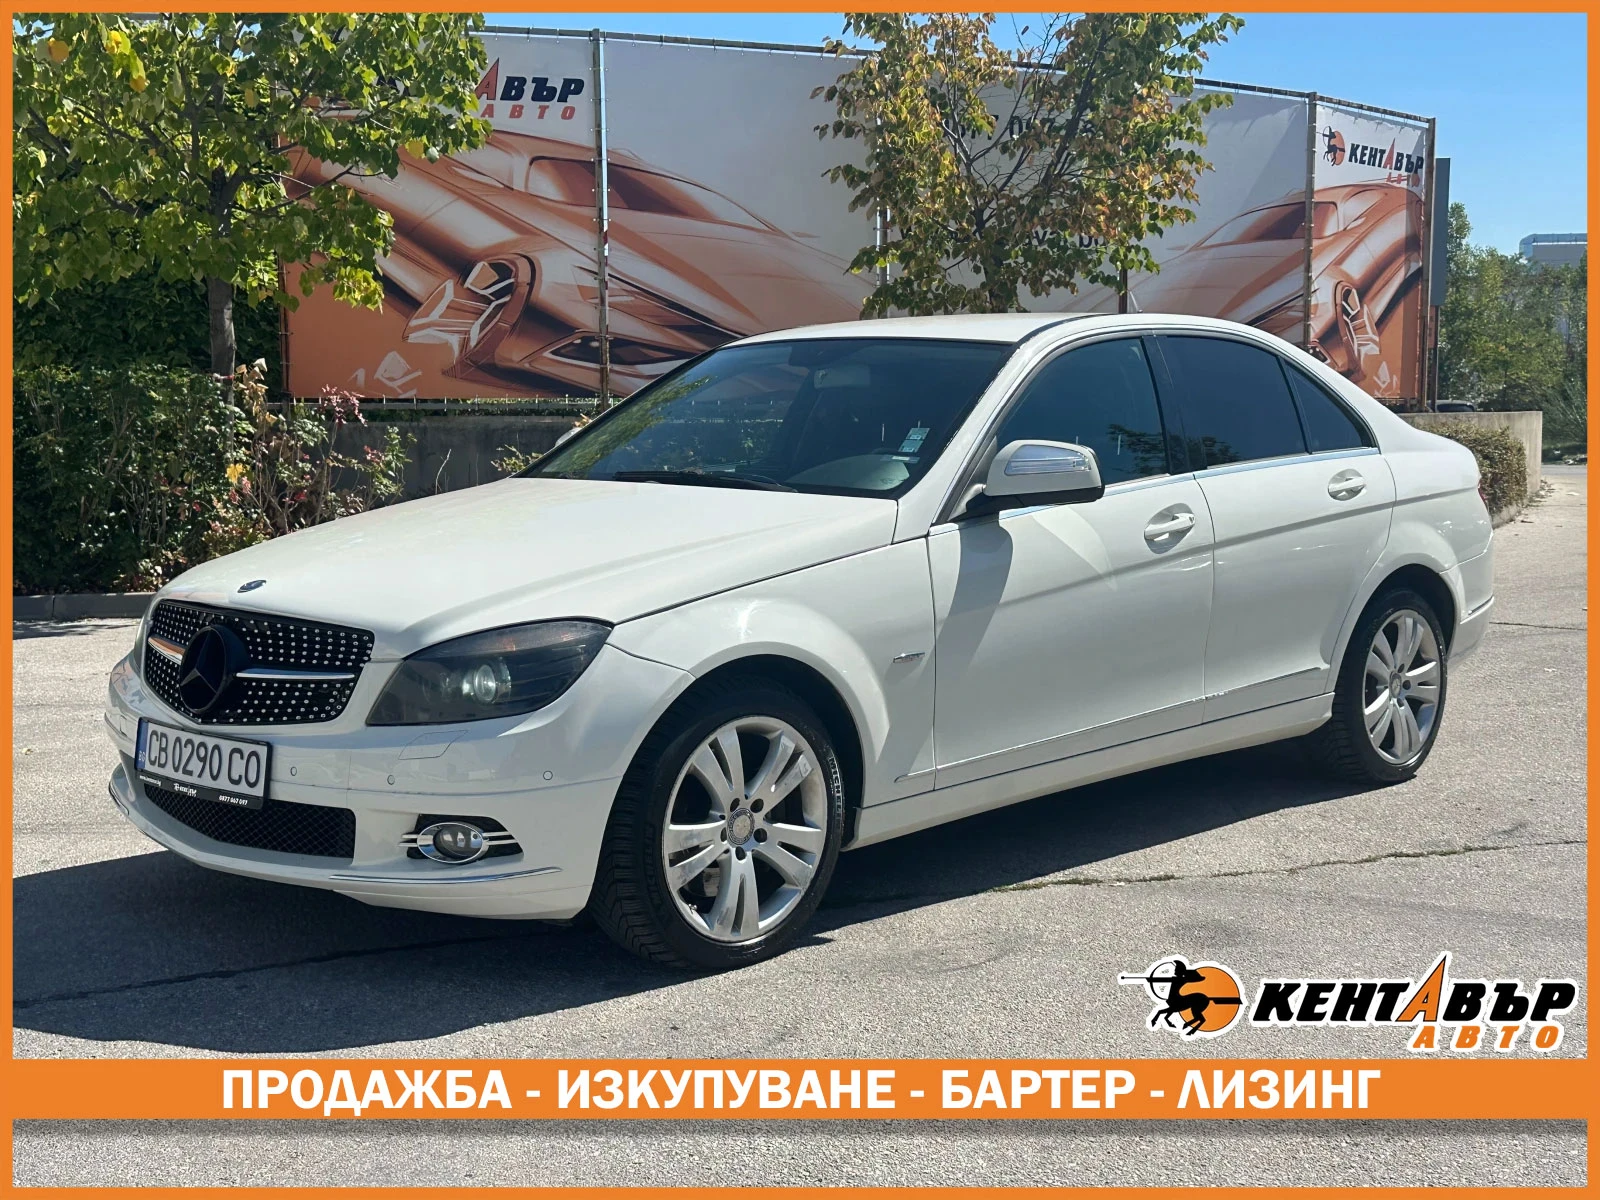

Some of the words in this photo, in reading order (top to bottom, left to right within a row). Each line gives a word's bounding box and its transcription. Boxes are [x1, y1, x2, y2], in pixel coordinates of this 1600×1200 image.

[480, 103, 576, 121] АВТО
[1348, 137, 1424, 175] КЕНТАВЪР
[148, 729, 169, 769] CB
[171, 736, 222, 782] 0290
